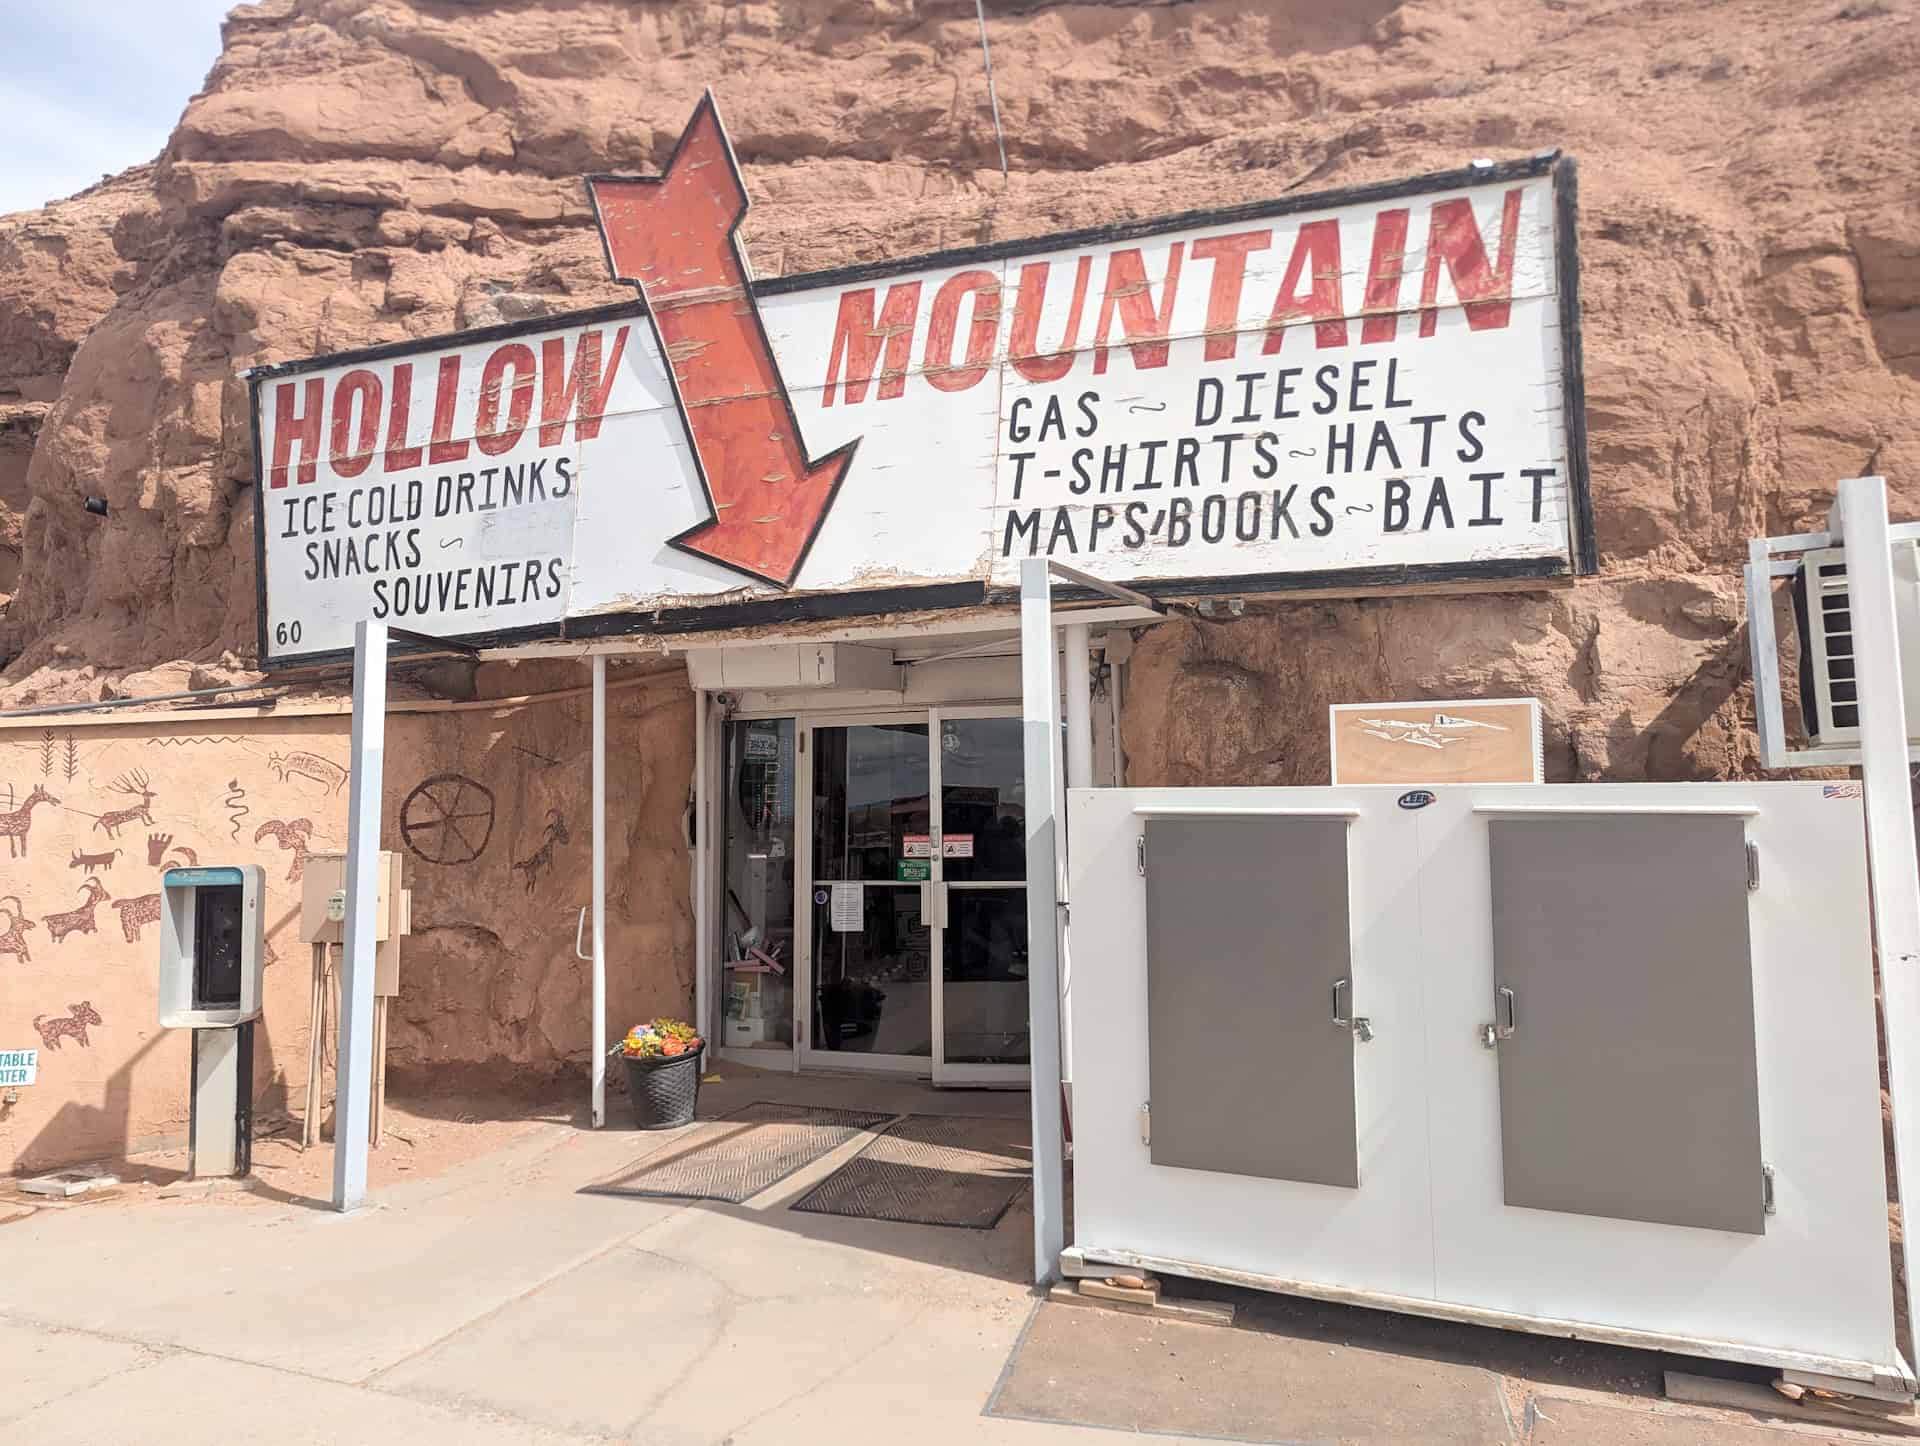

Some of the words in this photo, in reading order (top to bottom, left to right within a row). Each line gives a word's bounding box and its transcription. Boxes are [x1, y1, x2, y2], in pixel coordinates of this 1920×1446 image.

[270, 325, 631, 489] HOLLOW
[821, 189, 1523, 408] MOUNTAIN
[1008, 391, 1100, 443] GAS
[1195, 358, 1413, 427] DIESEL
[280, 491, 337, 539] ICE
[347, 480, 424, 529] COLD
[434, 456, 572, 517] DRINKS
[1382, 468, 1557, 533] BAIT
[304, 528, 422, 581] SNACKS
[372, 557, 563, 619] SOUVENIRS
[275, 620, 302, 646] 60
